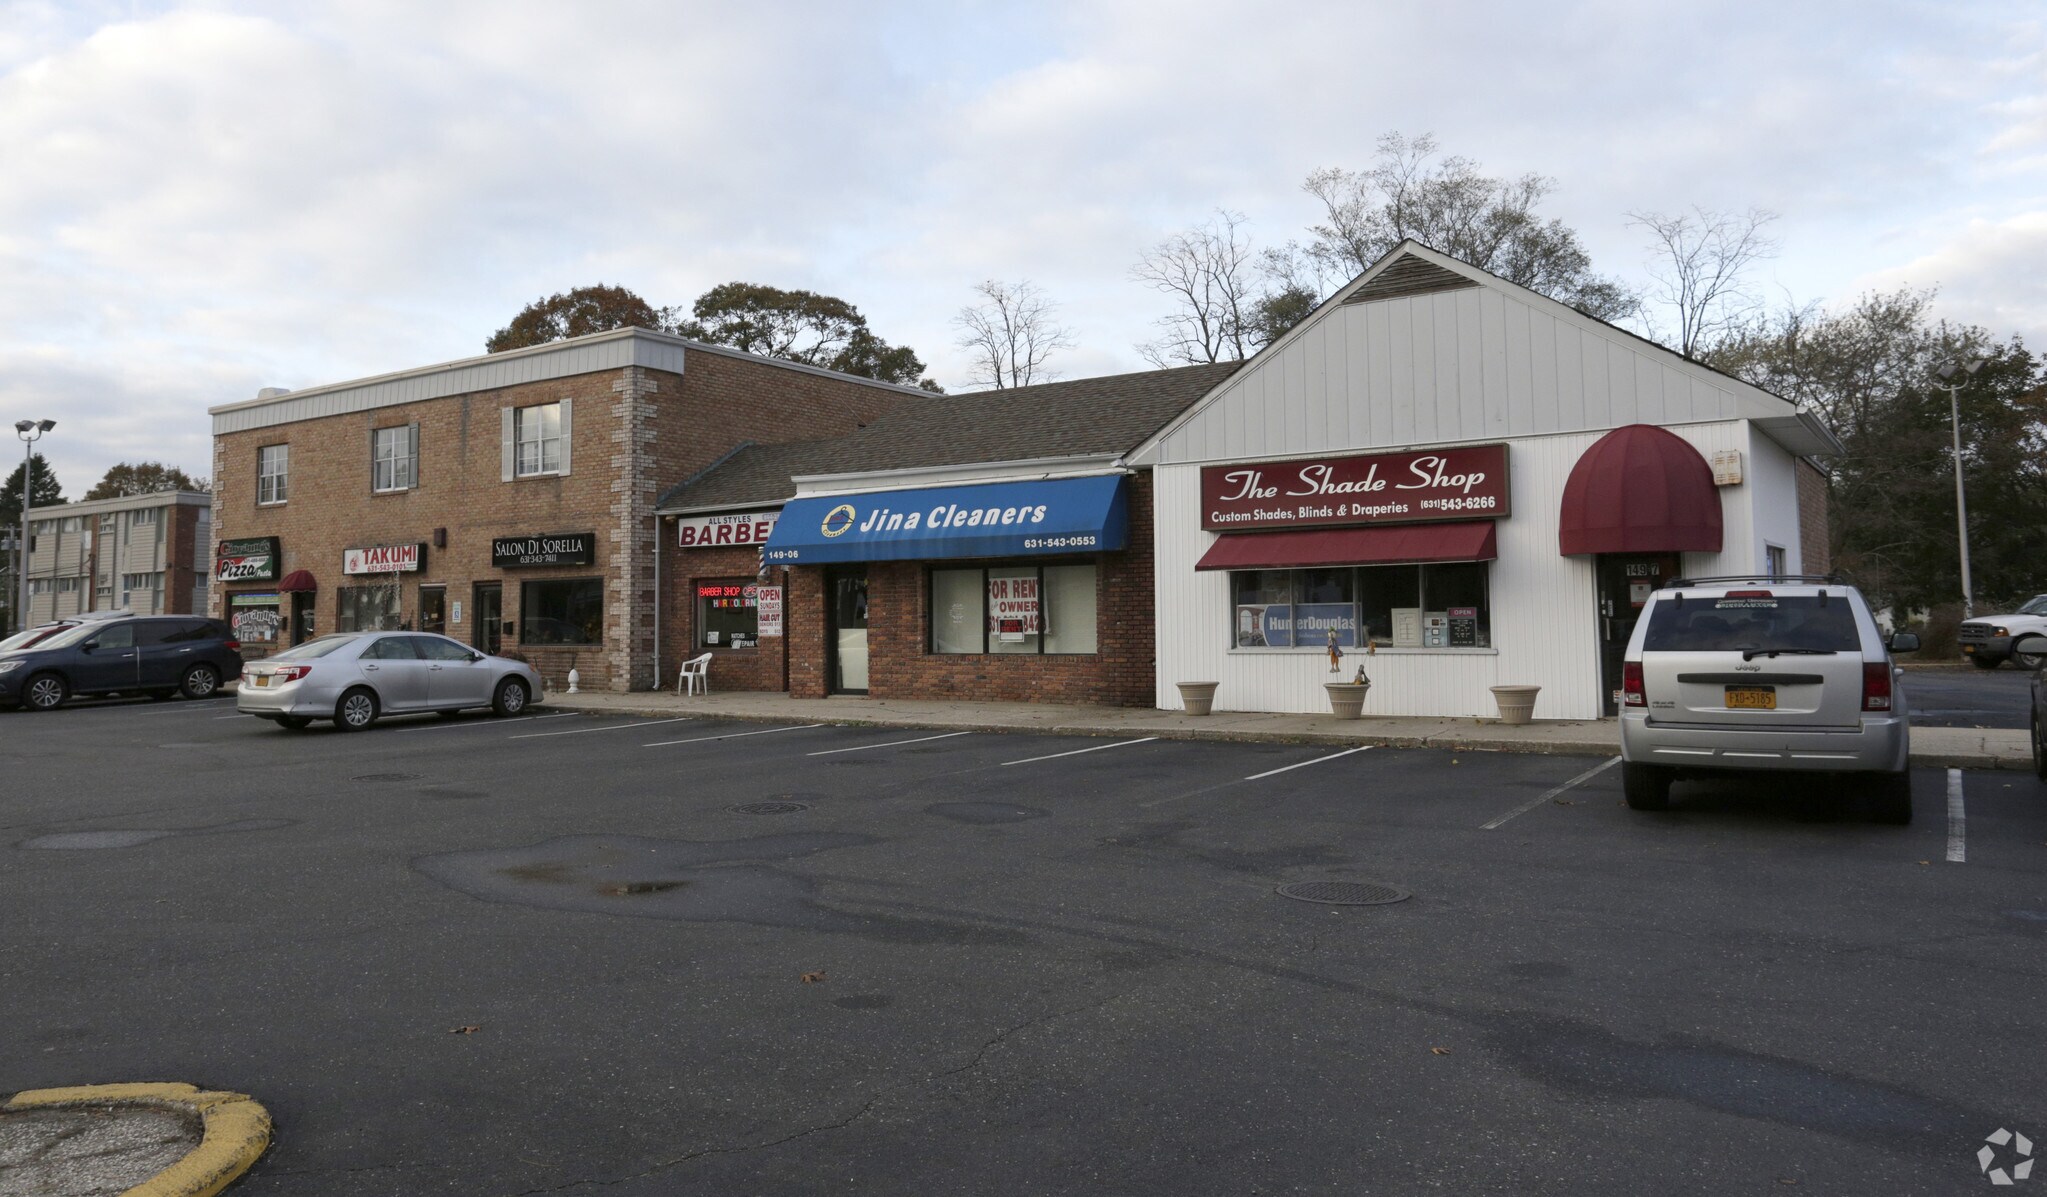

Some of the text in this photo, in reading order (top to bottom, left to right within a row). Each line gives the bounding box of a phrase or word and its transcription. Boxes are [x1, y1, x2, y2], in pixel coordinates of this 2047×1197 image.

[1219, 456, 1485, 500] The Shade Shop
[860, 503, 1047, 533] Jina Cleaners
[1211, 501, 1409, 523] Custom Shades, Blinds & Draperies
[708, 517, 722, 525] ALL
[723, 515, 752, 524] STYLES
[680, 521, 778, 546] BARBE
[1024, 537, 1096, 549] 631-543-0553
[362, 545, 417, 566] TAKUMI
[768, 550, 799, 559] 149-06
[220, 560, 257, 578] Pizza
[699, 586, 741, 597] BARBER SHOP
[760, 589, 780, 601] OPEN
[760, 602, 780, 610] SUNDAYS
[999, 601, 1039, 613] OWNER
[771, 613, 780, 621] CUT
[1269, 616, 1355, 631] HunerDouglas
